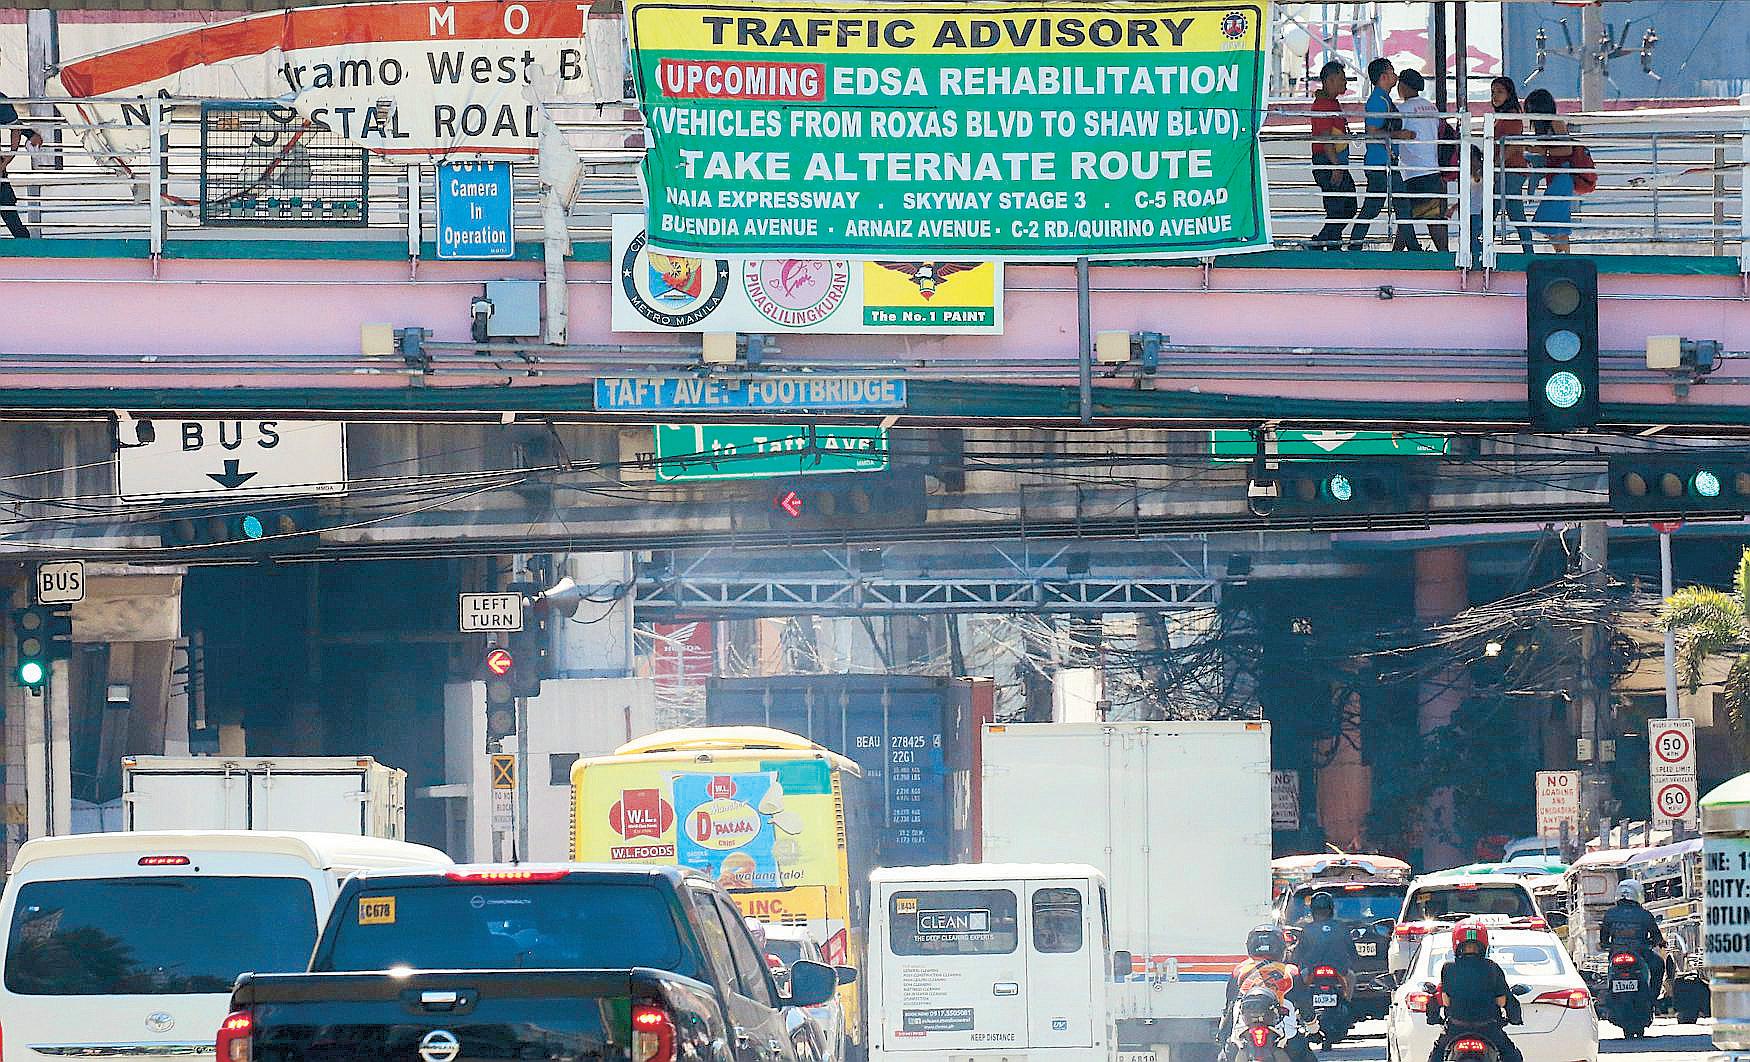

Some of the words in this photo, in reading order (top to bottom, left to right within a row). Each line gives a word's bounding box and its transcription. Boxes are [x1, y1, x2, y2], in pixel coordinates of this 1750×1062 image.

[702, 16, 916, 48] TRAFFIC
[932, 17, 1196, 48] ADVISORY
[427, 50, 535, 84] West
[833, 66, 928, 97] EDSA
[940, 64, 1240, 96] REHABILITATION
[652, 106, 782, 138] (VEHICLES
[790, 109, 862, 138] FROM
[870, 110, 958, 138] ROXAS
[966, 110, 1033, 138] BLVD
[1041, 111, 1076, 138] TO
[1083, 110, 1160, 138] SHAW
[679, 149, 791, 181] TAKE
[803, 152, 1057, 181] ALTERNATE
[1071, 149, 1213, 181] ROUTE
[451, 179, 498, 197] Camera
[666, 187, 713, 208] NAIA
[718, 190, 861, 209] EXPRESSWAY
[1134, 190, 1167, 209] C-5
[1172, 187, 1229, 208] ROAD
[902, 192, 993, 210] SKYWAY
[998, 191, 1068, 209] STAGE
[1074, 191, 1087, 209] 3
[470, 202, 482, 220] In
[661, 214, 740, 236] BUENDIA
[744, 218, 818, 237] AVENUE
[845, 219, 913, 237] ARNAIZ
[918, 219, 992, 238] AVENUE
[1011, 220, 1039, 238] C-2
[1159, 214, 1233, 237] AVENUE
[444, 226, 506, 248] Operation
[745, 272, 848, 325] PINAGLILINGKURAN
[631, 294, 672, 325] METRO
[675, 296, 721, 326] MANILA
[871, 311, 896, 321] The
[943, 311, 986, 322] PAINT
[605, 378, 664, 405] TAFT
[748, 378, 896, 404] FOOTBRIDGE
[181, 420, 280, 451] BUS
[43, 572, 80, 592] BUS
[473, 598, 509, 611] LEFT
[470, 614, 513, 627] TURN
[856, 736, 881, 748] BEAU
[892, 736, 925, 748] 278425
[1663, 738, 1682, 750] 50
[1547, 775, 1568, 787] NO
[1665, 791, 1685, 804] 60
[627, 809, 657, 823] W.L.
[749, 899, 788, 914] INC.
[986, 1033, 1016, 1041] DISTANCE
